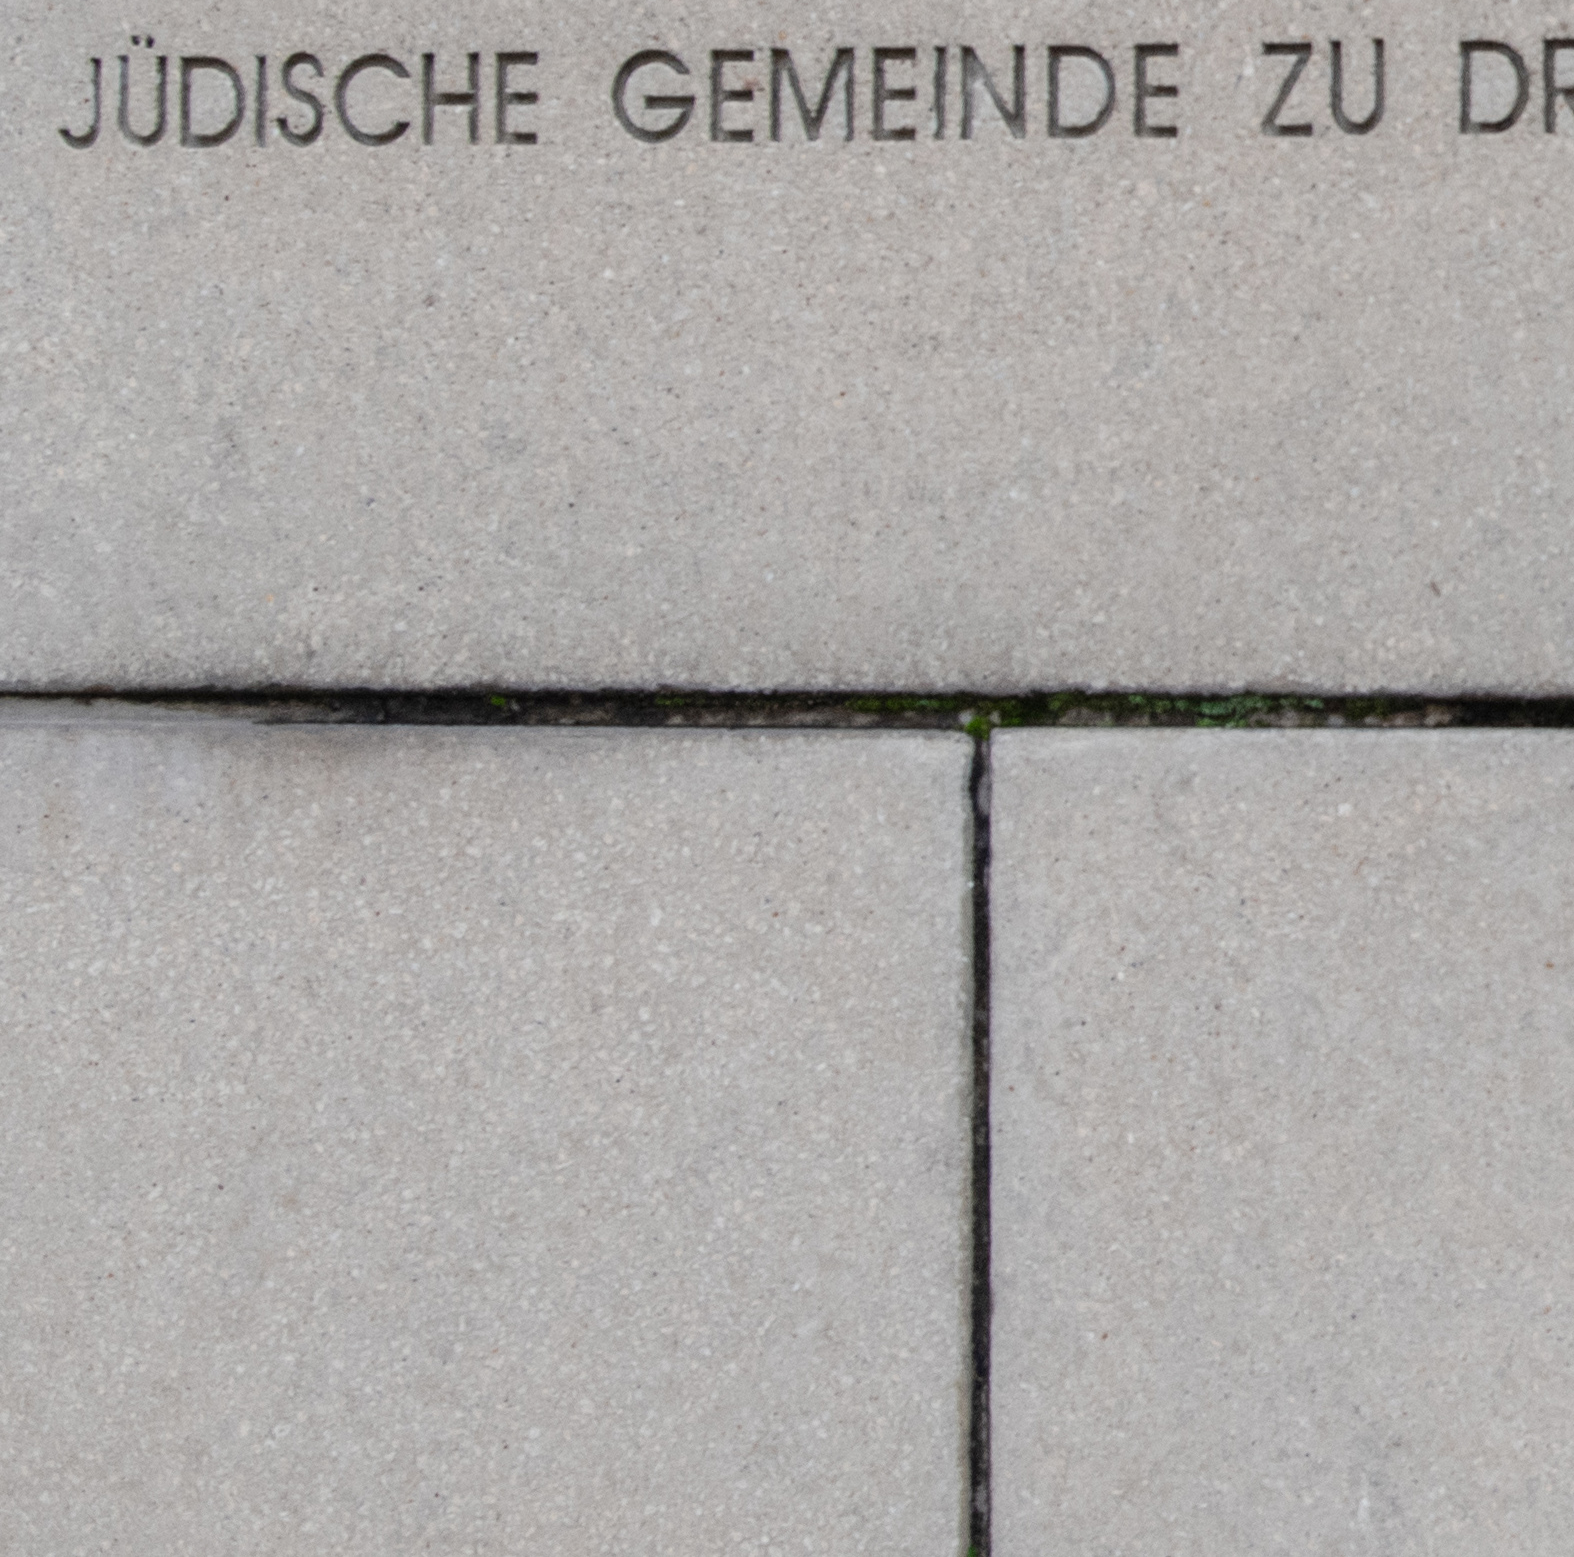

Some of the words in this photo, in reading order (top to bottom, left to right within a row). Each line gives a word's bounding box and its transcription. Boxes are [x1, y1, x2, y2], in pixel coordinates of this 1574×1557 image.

[57, 35, 541, 149] JÜDISCHE
[610, 43, 1179, 143] GEMEINDE
[1260, 37, 1386, 137] ZU
